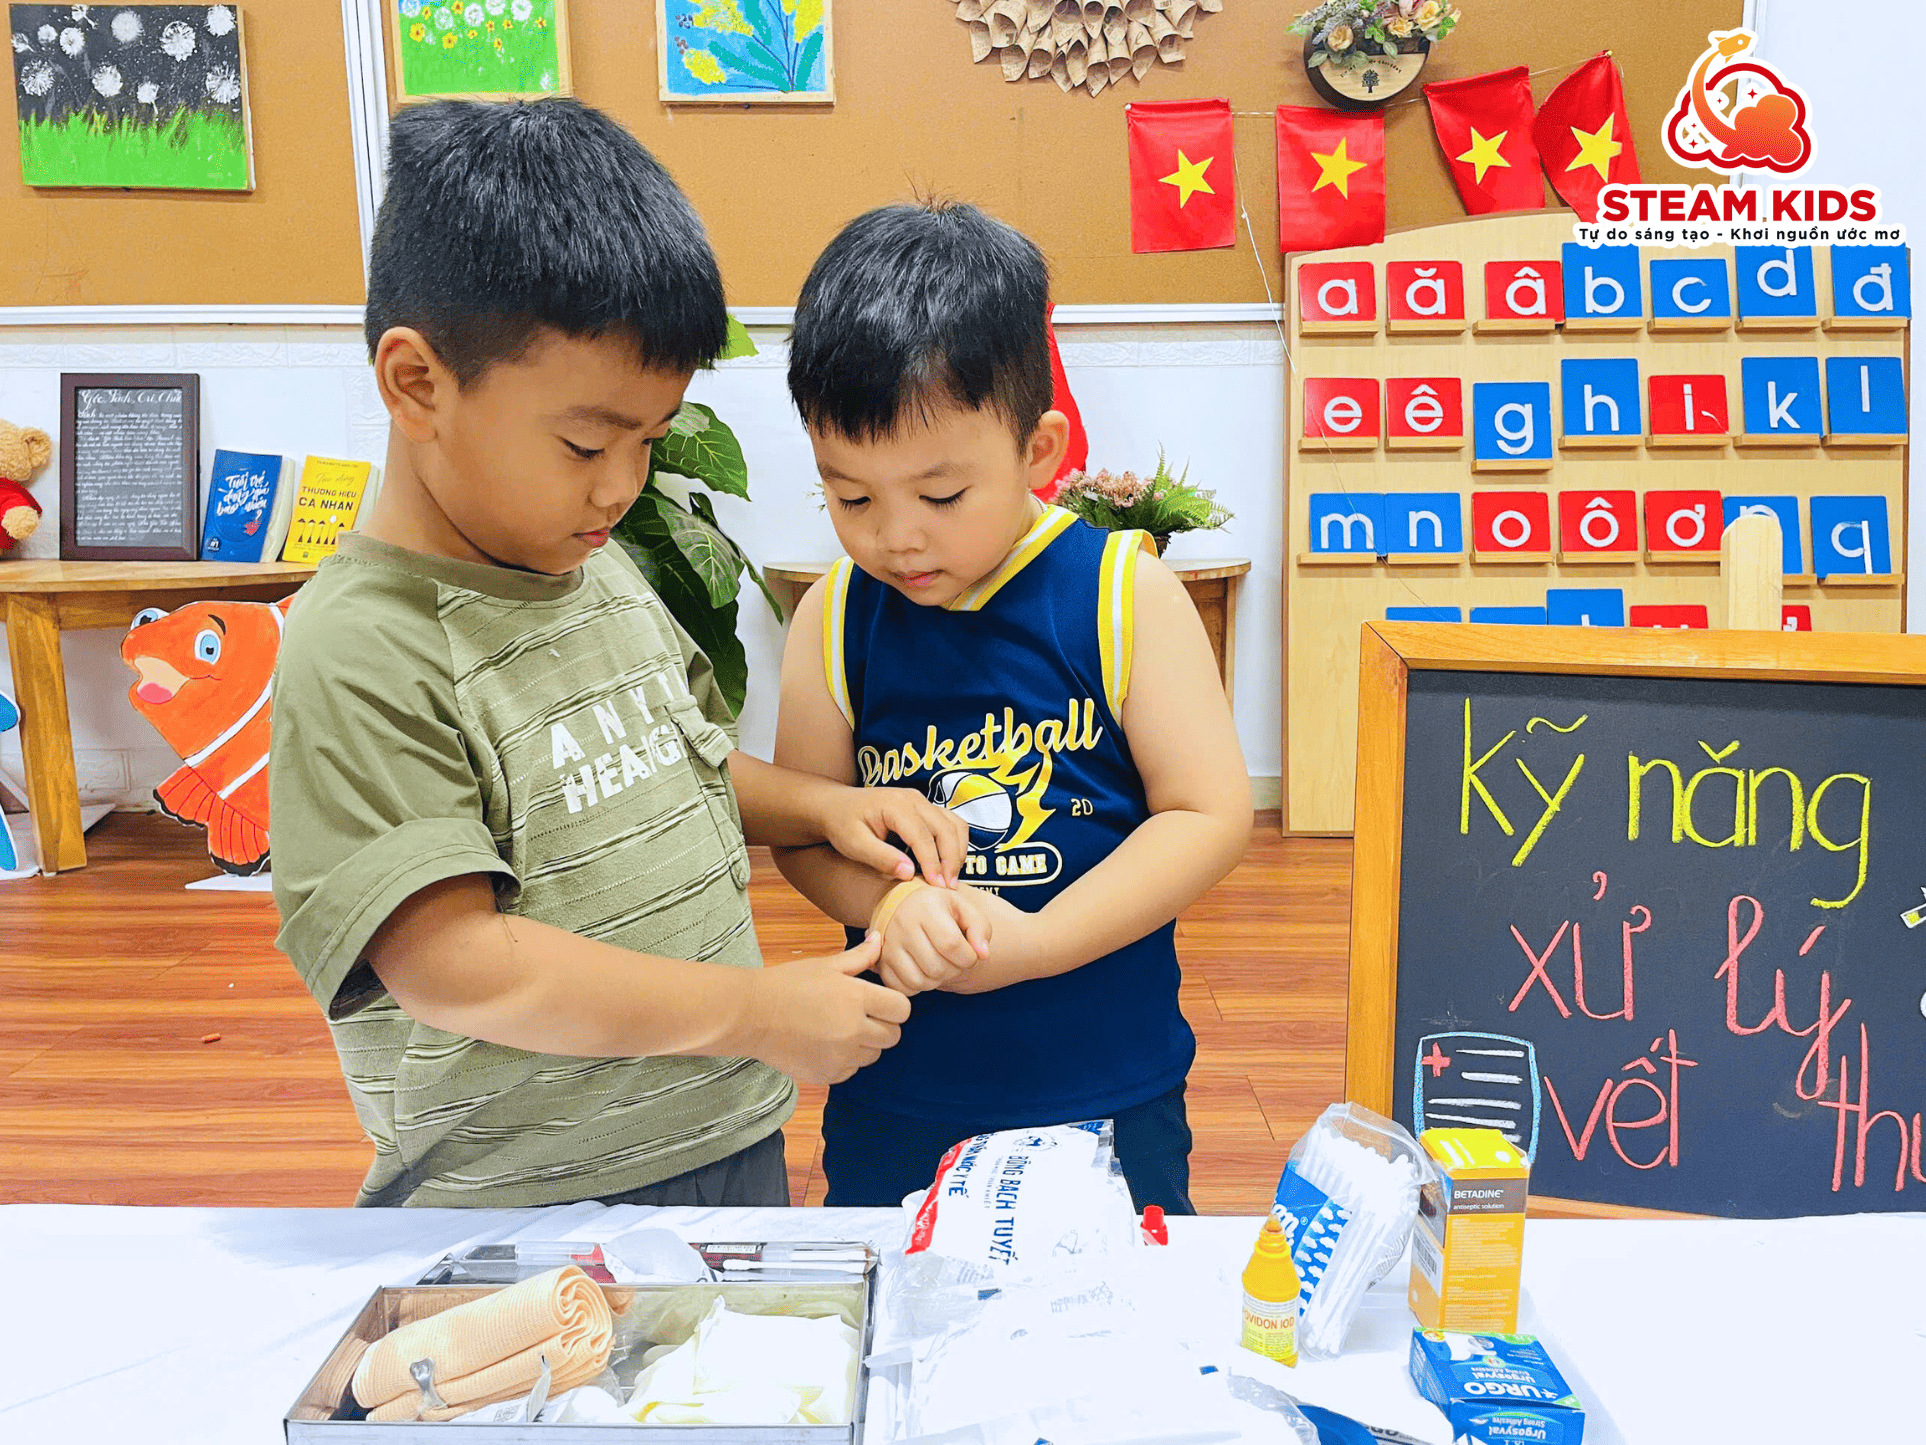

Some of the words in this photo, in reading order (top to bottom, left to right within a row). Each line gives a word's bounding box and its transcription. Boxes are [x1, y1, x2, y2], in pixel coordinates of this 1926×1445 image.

[1317, 278, 1358, 315] a
[1405, 267, 1446, 316] ă
[1505, 266, 1546, 316] â
[1585, 266, 1625, 314] b
[1672, 276, 1712, 313] c
[1757, 249, 1797, 297] d
[1853, 263, 1894, 312] đ
[1323, 396, 1362, 433] e
[1404, 384, 1444, 433] ê
[1494, 403, 1534, 455] g
[1584, 384, 1620, 432] h
[1683, 383, 1695, 431] i
[1767, 381, 1800, 429] k
[1861, 365, 1870, 412] l
[1320, 512, 1374, 549] m
[1409, 510, 1443, 547] n
[1492, 510, 1531, 548] o
[1579, 497, 1619, 548] ô
[1666, 504, 1706, 547] ơ
[1831, 520, 1873, 575] q
[858, 698, 1103, 789] Basketball
[1627, 740, 1871, 910] năng
[965, 854, 988, 875] TO
[995, 853, 1047, 876] GAME
[1508, 871, 1652, 1021] xử
[1714, 895, 1852, 1100] lý
[1543, 1029, 1698, 1169] vết
[1002, 1155, 1032, 1176] BÔNG
[949, 1180, 969, 1199] TẾ
[995, 1179, 1022, 1210] BẠCH
[1454, 1189, 1501, 1199] BETADINE
[988, 1216, 1019, 1266] TUYẾT
[1464, 1382, 1543, 1399] URGO
[1488, 1426, 1546, 1440] Urgosyval
[1492, 1418, 1522, 1427] Adhesive
[1523, 1419, 1546, 1428] Strong
